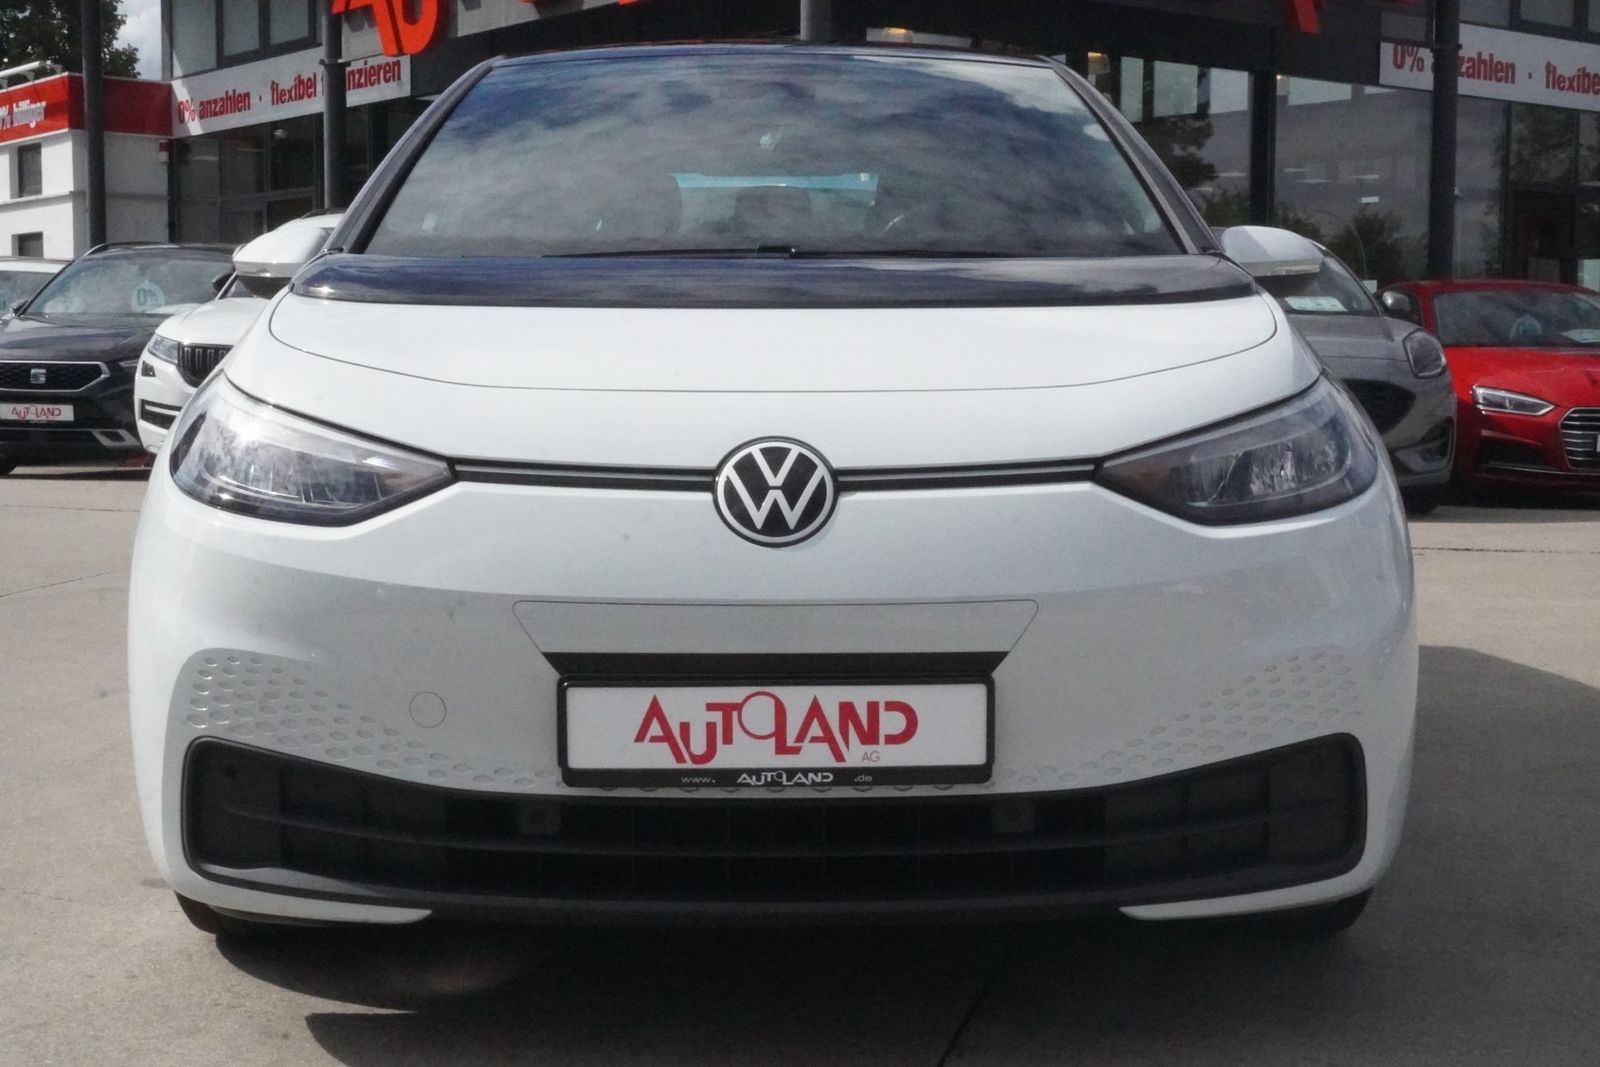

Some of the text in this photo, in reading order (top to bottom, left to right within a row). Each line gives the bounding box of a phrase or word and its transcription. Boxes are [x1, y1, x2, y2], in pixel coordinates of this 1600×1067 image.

[1392, 43, 1425, 73] 0%
[1431, 51, 1516, 84] zahlen
[178, 98, 195, 124] 0%
[199, 89, 251, 120] anzahlen
[271, 72, 317, 105] flexibel
[11, 404, 62, 419] AUTOLAND
[633, 690, 919, 766] AUTOLAND
[861, 751, 881, 764] AG
[681, 770, 873, 786] www. AUTOLAND .de
